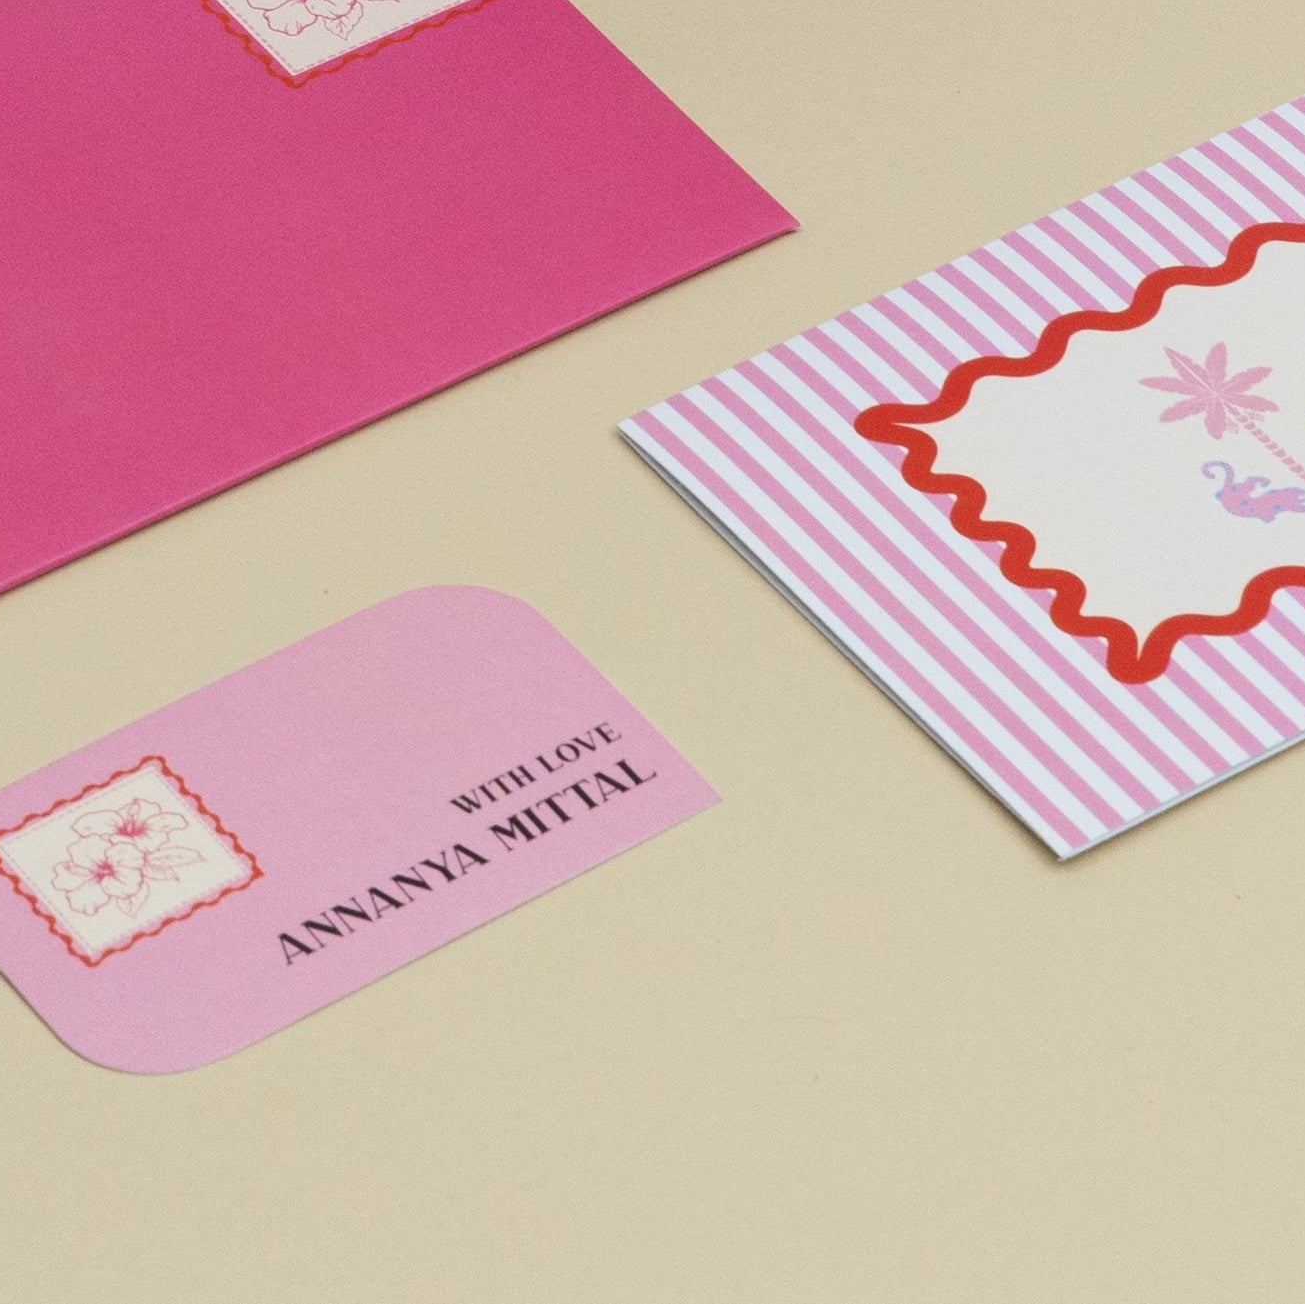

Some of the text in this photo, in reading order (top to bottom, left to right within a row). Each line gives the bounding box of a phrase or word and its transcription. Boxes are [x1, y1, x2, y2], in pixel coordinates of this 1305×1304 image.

[449, 721, 622, 815] WITH LOVE
[277, 758, 658, 966] ANNANYA MITTAL
